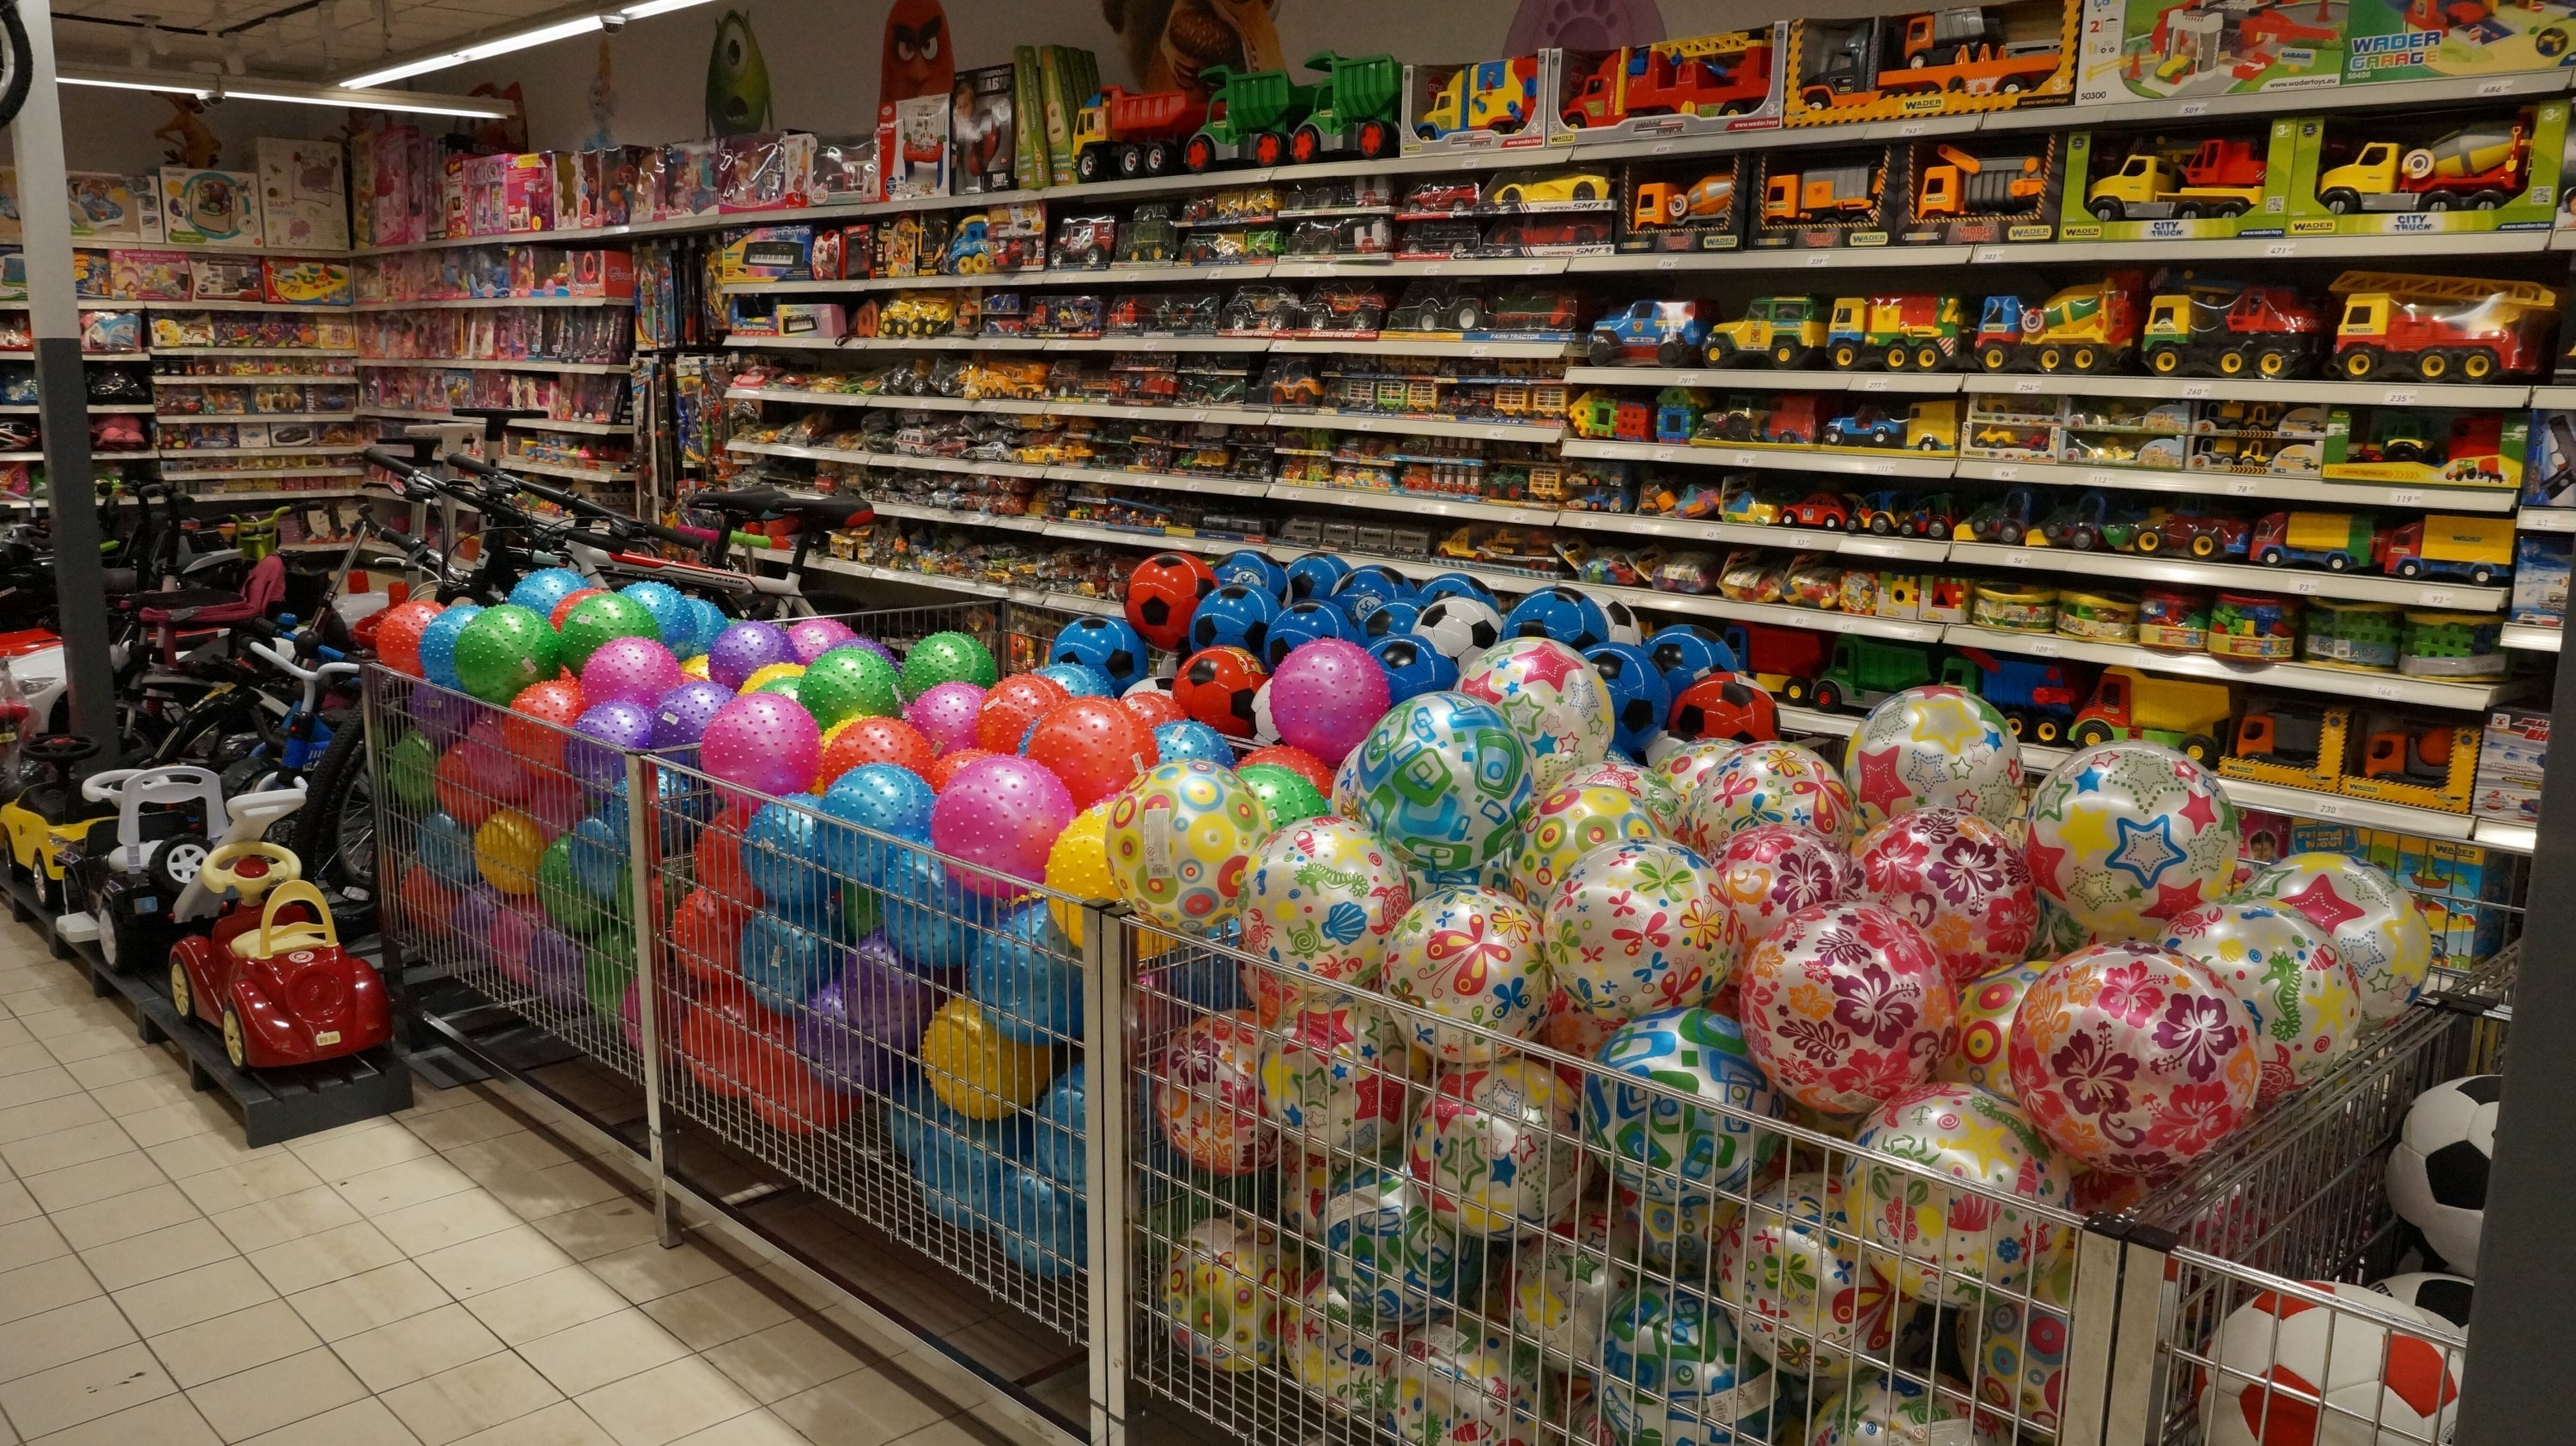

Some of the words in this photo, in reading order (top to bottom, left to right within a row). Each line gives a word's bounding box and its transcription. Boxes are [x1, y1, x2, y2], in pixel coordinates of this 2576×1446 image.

[2353, 30, 2442, 53] WADER
[2350, 49, 2439, 70] GARAGE
[1570, 71, 1584, 83] STOP
[2269, 77, 2336, 88] www.wadertoys.eu
[1428, 82, 1443, 94] STOP
[2081, 91, 2106, 100] 50300
[1766, 104, 1780, 115] 3+
[1905, 99, 1941, 110] WADER
[2543, 108, 2561, 121] 3+
[1734, 118, 1779, 128] www.wader.toys
[1904, 127, 1917, 136] 763
[2276, 125, 2290, 136] 3+
[1507, 137, 1542, 147] www.wader.toys
[1551, 134, 1574, 143] WADER
[1054, 173, 1069, 181] ТАРА
[1572, 201, 1601, 211] SM7
[2397, 215, 2427, 224] CITY
[2154, 222, 2179, 230] CITY
[2293, 222, 2333, 232] WADER
[2394, 222, 2432, 232] TRUCK
[2011, 227, 2050, 238] WADER
[2065, 228, 2099, 236] WADER
[2151, 228, 2184, 237] TRUCK
[1705, 237, 1736, 246] WADER
[1852, 234, 1886, 244] WADER
[1575, 246, 1601, 256] SM7
[714, 576, 744, 586] BASIS
[2298, 583, 2310, 592] 93
[2432, 595, 2444, 604] 93
[2227, 764, 2254, 774] WADER
[2348, 783, 2378, 793] WADER
[2320, 805, 2336, 814] 230
[2434, 844, 2476, 857] WADER
